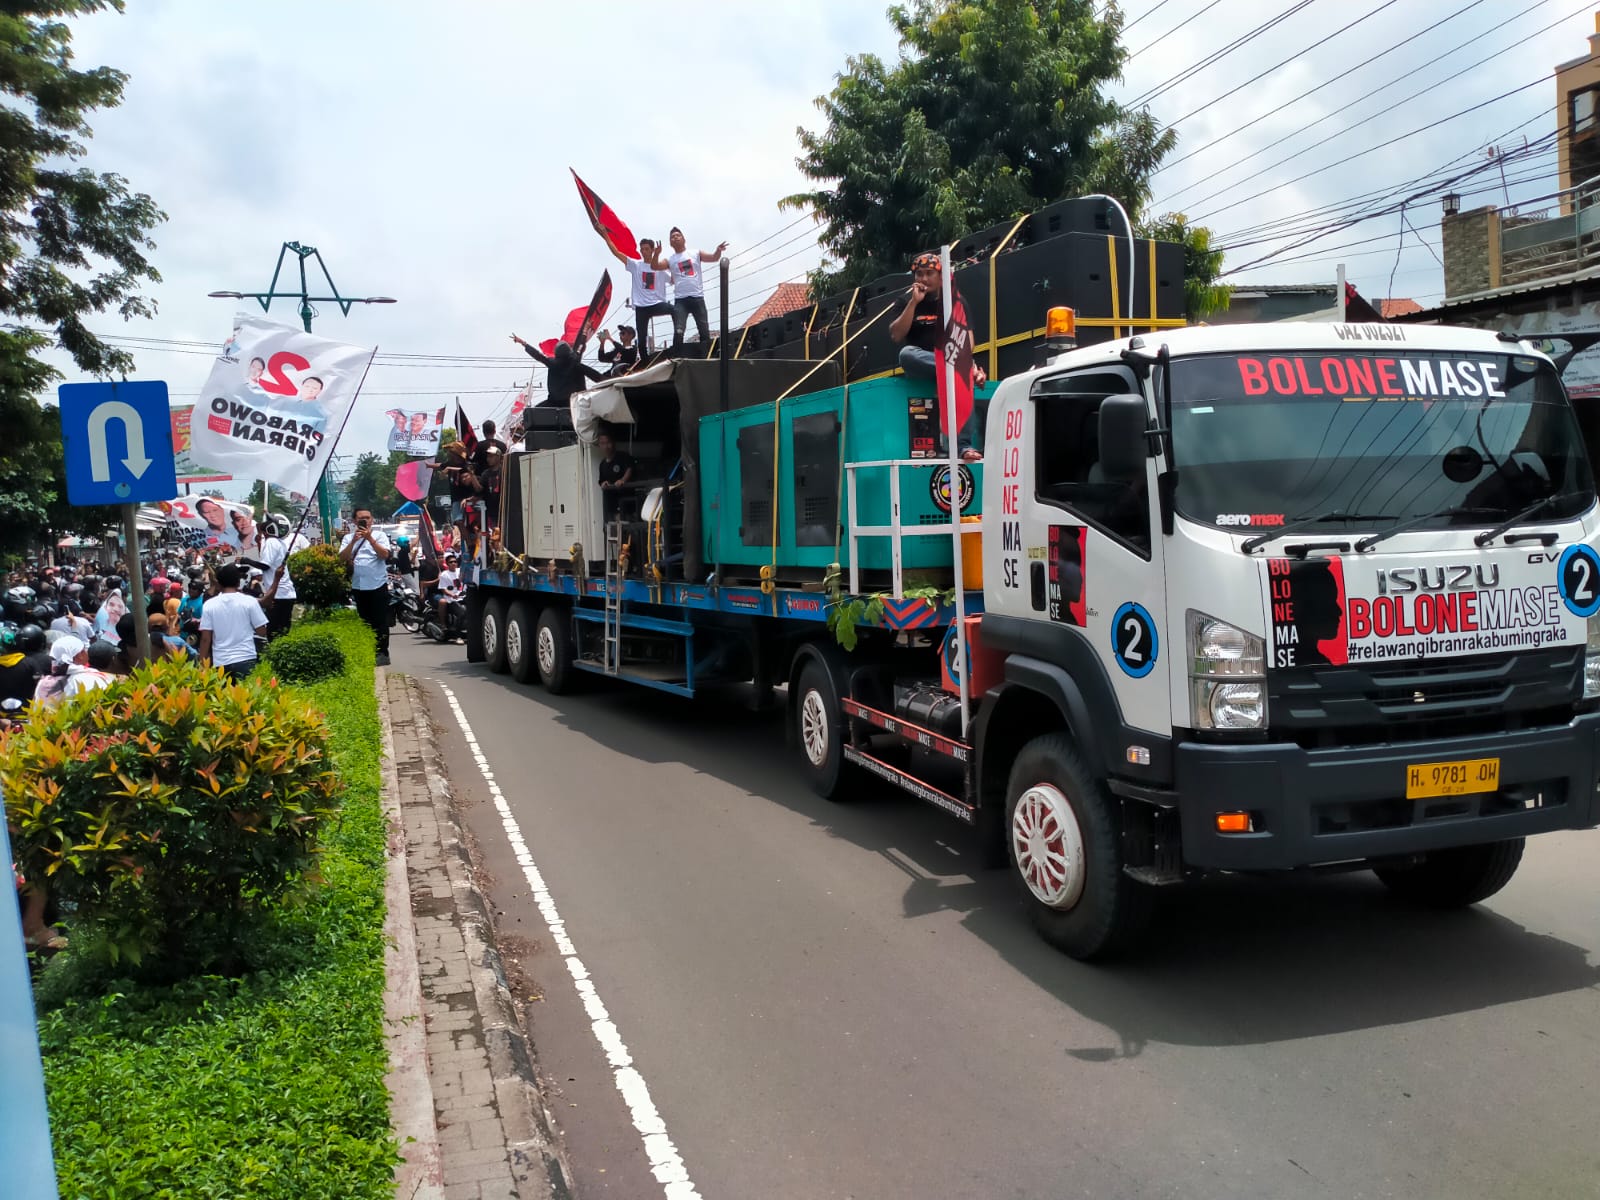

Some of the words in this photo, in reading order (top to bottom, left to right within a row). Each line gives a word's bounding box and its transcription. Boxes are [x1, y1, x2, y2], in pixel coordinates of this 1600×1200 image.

[1006, 408, 1022, 440] BO
[1004, 447, 1019, 478] LO
[1003, 484, 1018, 515] NE
[1215, 512, 1285, 526] aeromax
[1002, 521, 1021, 551] MA
[1003, 558, 1019, 589] SE
[1270, 558, 1291, 576] BO
[1376, 563, 1500, 594] ISUZU
[1572, 558, 1592, 600] 2
[1273, 579, 1291, 599] LO
[1275, 602, 1294, 622] NE
[1124, 618, 1143, 662] 2
[1277, 625, 1299, 645] MA
[1348, 627, 1567, 661] #relawangibranrakabumingraka
[1278, 648, 1296, 668] SE
[1432, 765, 1467, 785] 9781
